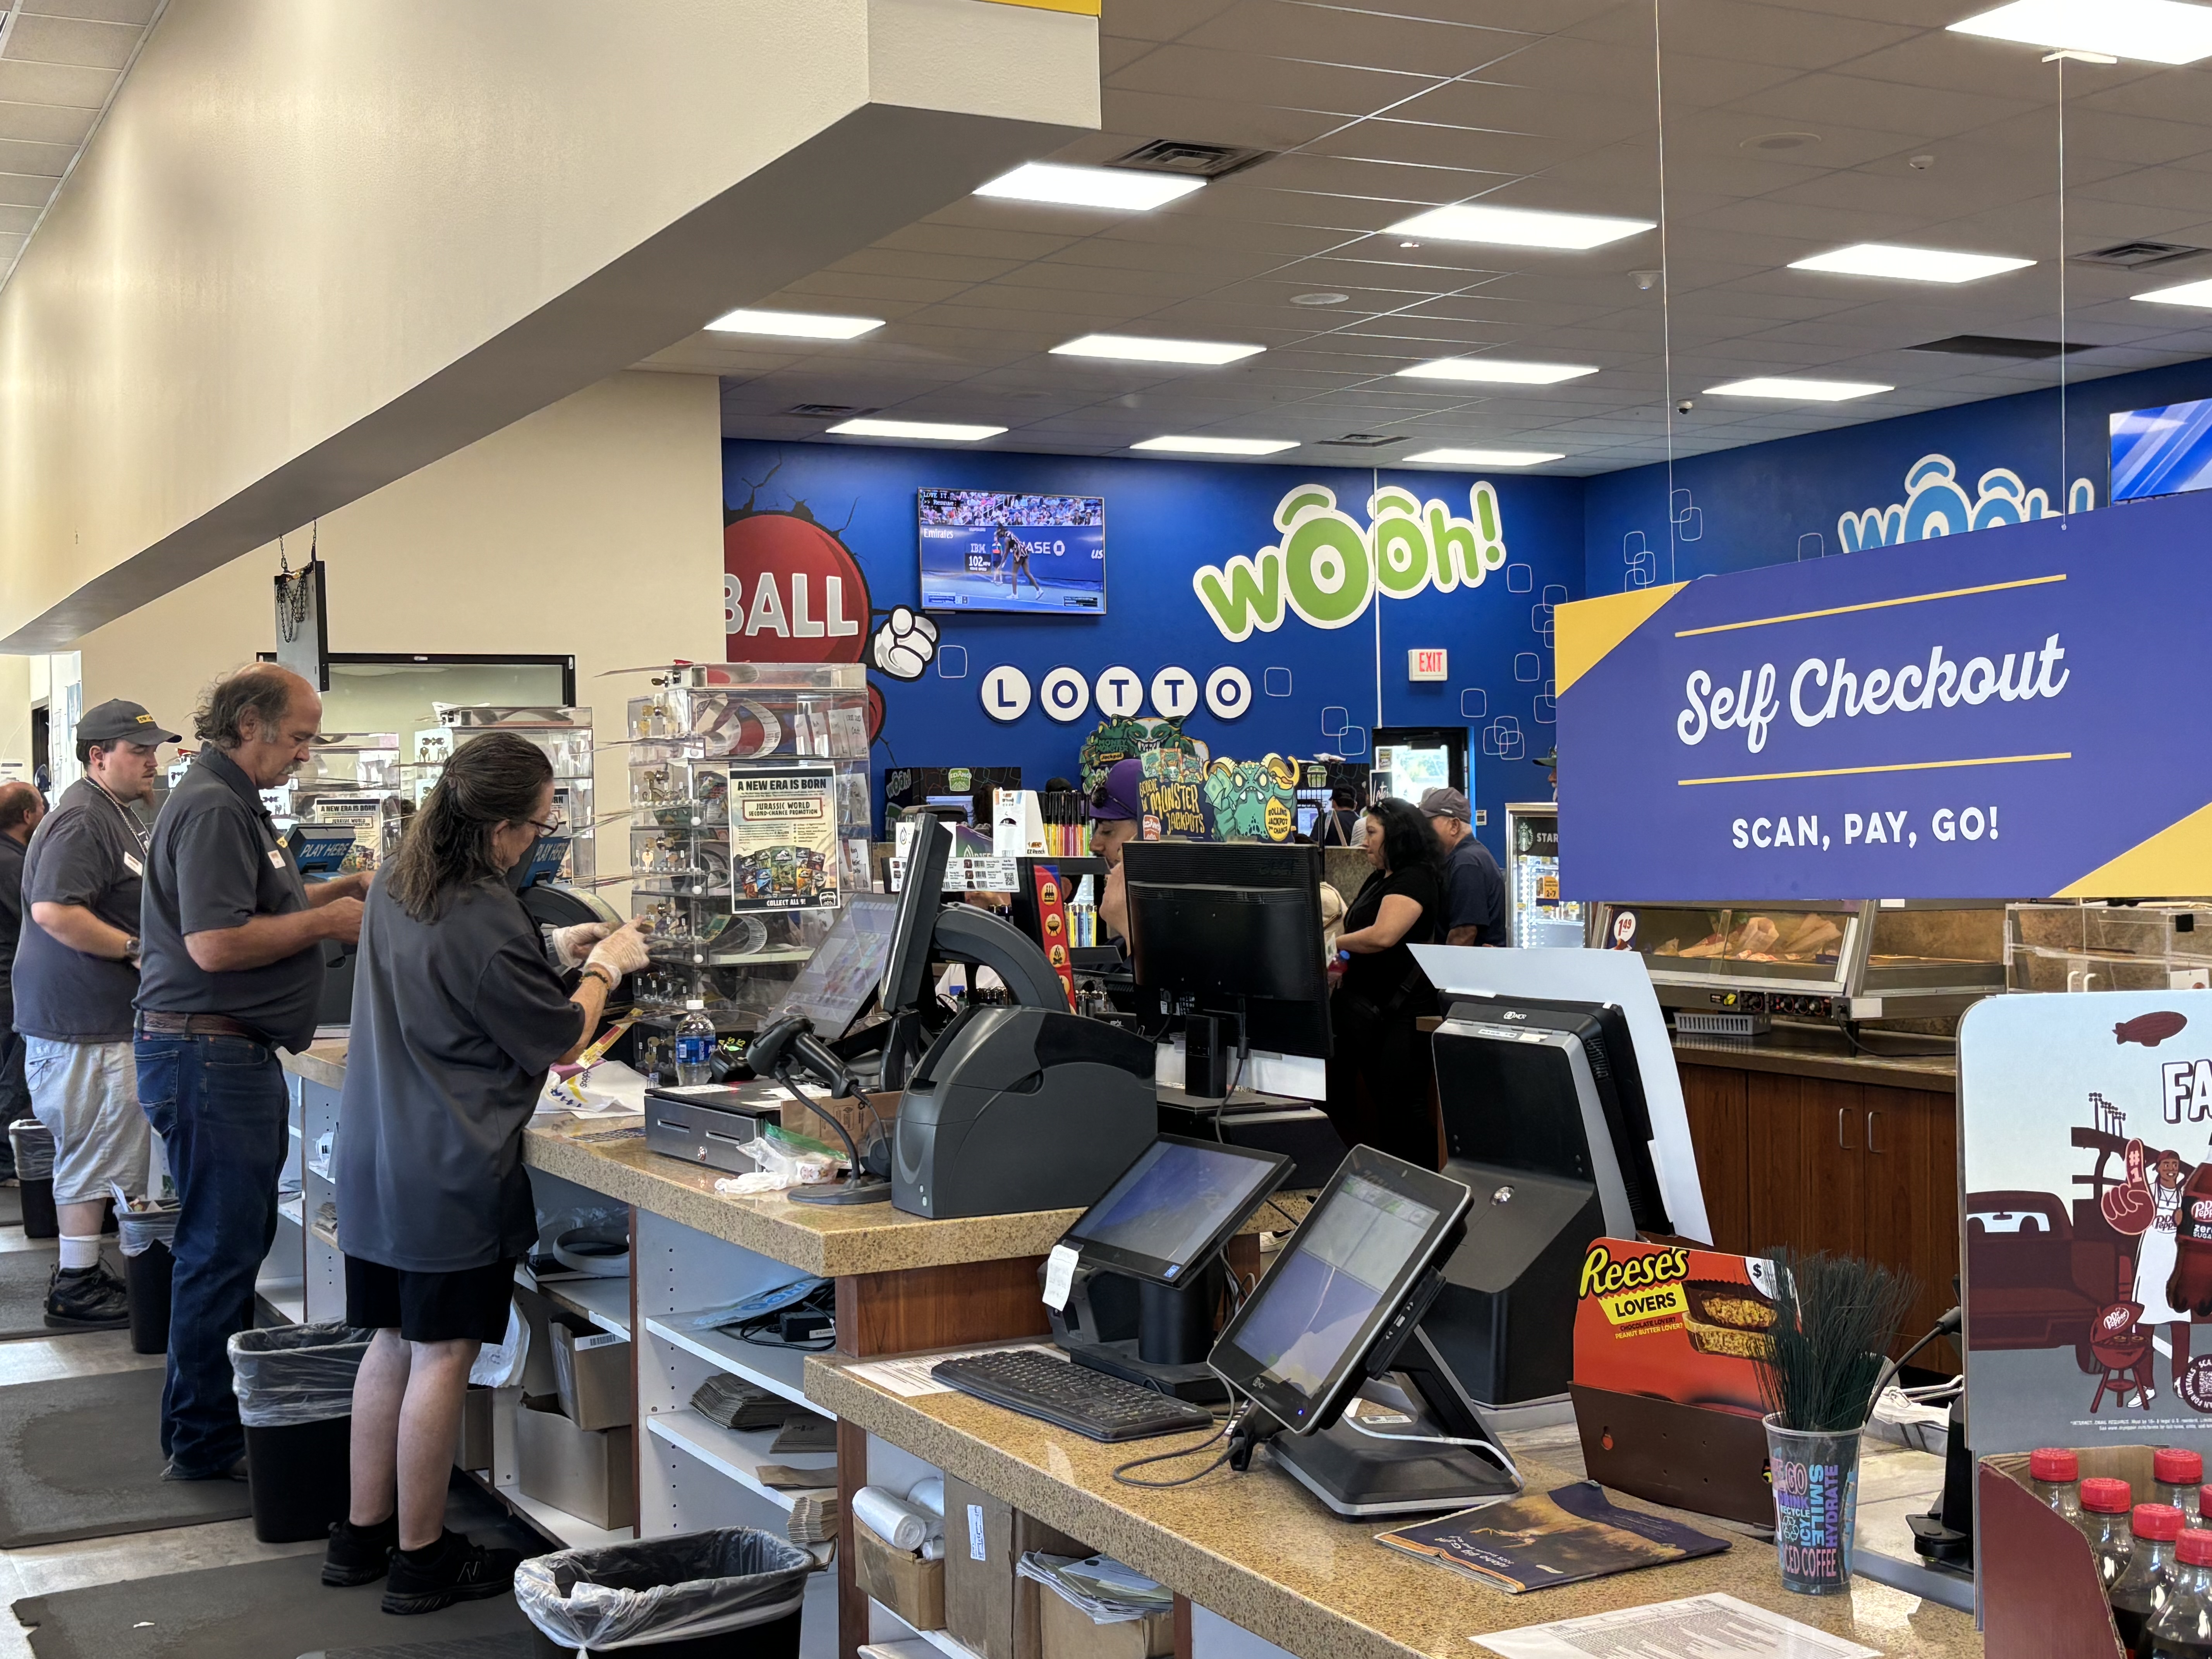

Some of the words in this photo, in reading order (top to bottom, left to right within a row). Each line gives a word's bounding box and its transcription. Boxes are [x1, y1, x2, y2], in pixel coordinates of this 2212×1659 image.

[924, 528, 953, 539] Emirates
[970, 543, 986, 553] IBM
[969, 556, 983, 566] 102
[1419, 651, 1443, 673] EXIT
[997, 678, 1241, 709] LOTTO
[1677, 663, 1779, 754] Self
[1789, 633, 2070, 728] Checkout
[738, 781, 744, 791] A
[746, 780, 767, 791] NEW
[770, 780, 788, 790] ERA
[790, 780, 799, 789] IS
[801, 778, 826, 789] BORN
[756, 802, 785, 810] JURASSIC
[1150, 783, 1200, 820] MONSTER
[1166, 812, 1205, 836] JACKPOTS
[1733, 814, 1830, 851] SCAN,
[1844, 810, 1918, 848] PAY,
[1932, 805, 1999, 841] GO!
[299, 843, 327, 858] PLAY
[323, 843, 350, 857] HERE
[533, 843, 553, 862] PLAY
[2131, 1169, 2142, 1183] 1
[2194, 1224, 2212, 1233] zer
[1579, 1246, 1688, 1298] Reese's
[1752, 1262, 1762, 1279] $
[1615, 1292, 1676, 1317] LOVERS
[1615, 1331, 1638, 1339] PEANUT
[1639, 1327, 1661, 1335] BUTTER
[1662, 1322, 1683, 1331] LOVER?
[1620, 1319, 1654, 1331] CHOCOLATE
[1654, 1317, 1676, 1325] LOVER?
[2185, 1367, 2196, 1395] DETAILS
[2190, 1394, 2203, 1407] FOR
[1785, 1462, 1808, 1496] GO
[1809, 1464, 1824, 1546] SMILE
[1824, 1465, 1838, 1548] HYDRATE
[1800, 1518, 1811, 1546] ICY
[1479, 1555, 1510, 1568] Idaho
[1784, 1544, 1800, 1575] CED
[1802, 1547, 1837, 1577] COFFEE
